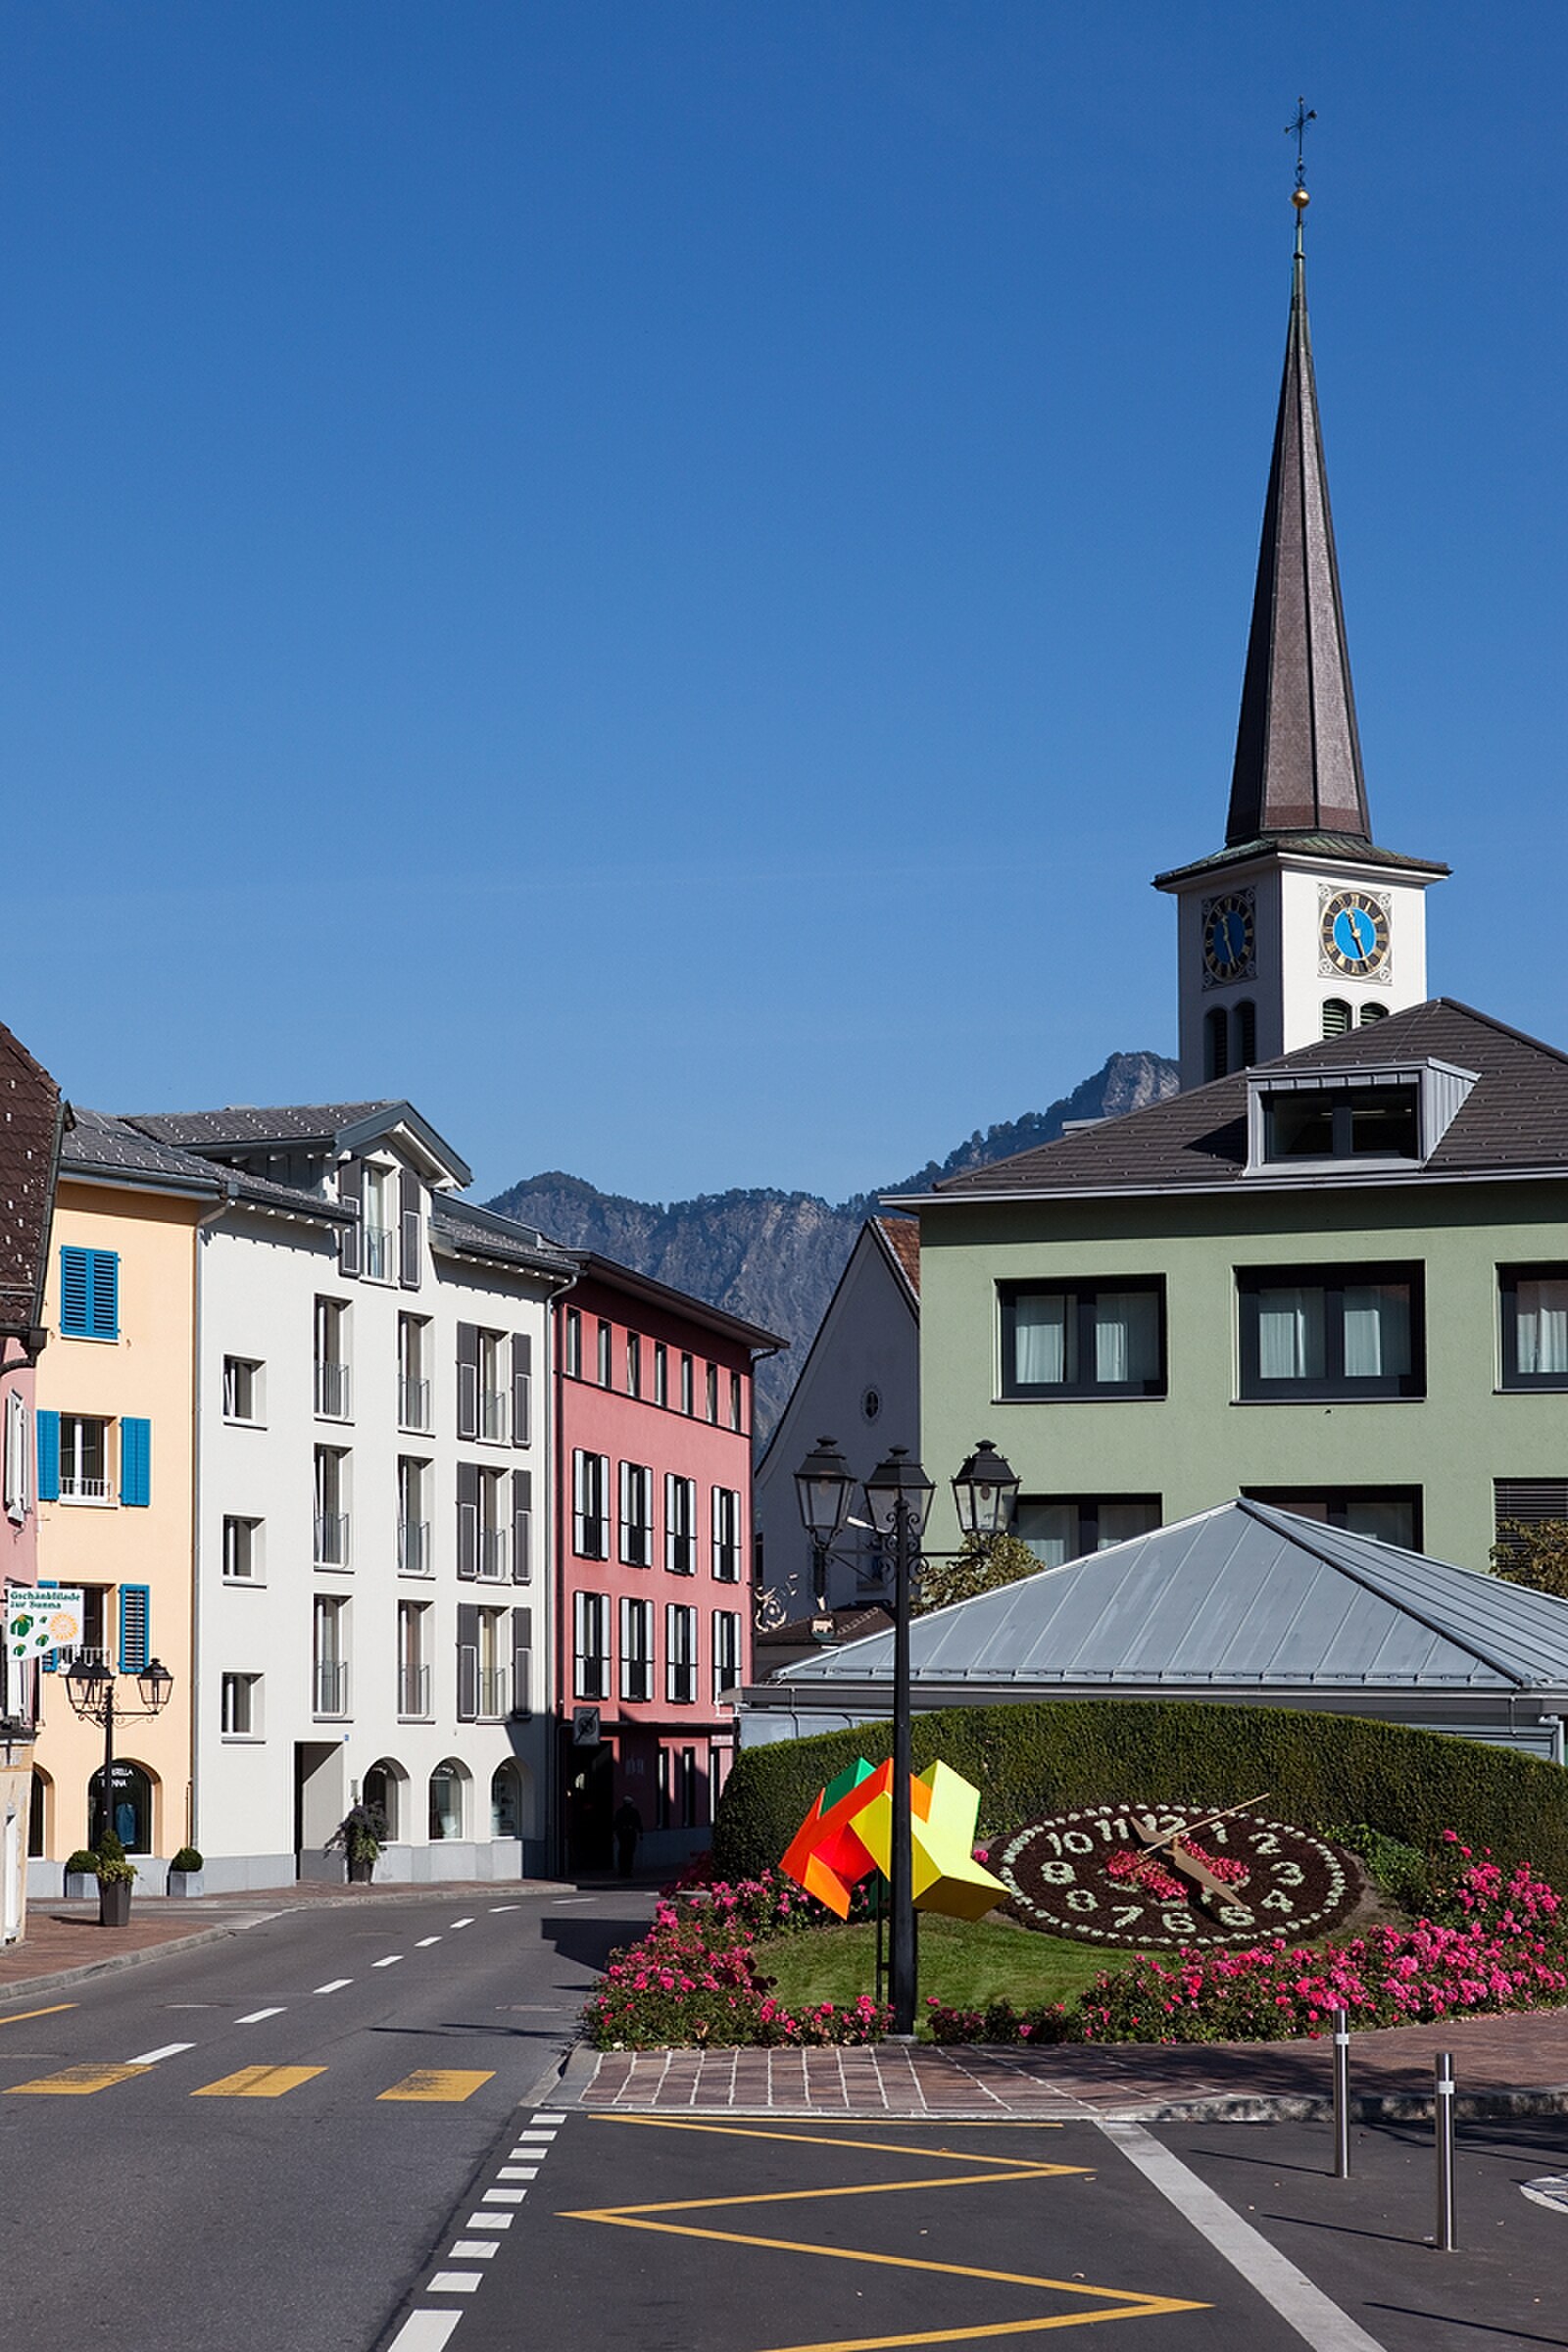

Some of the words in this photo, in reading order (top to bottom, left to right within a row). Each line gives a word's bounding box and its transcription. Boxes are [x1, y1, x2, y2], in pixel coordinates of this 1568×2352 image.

[1094, 1818, 1129, 1841] 11
[1142, 1814, 1187, 1836] 12
[1209, 1821, 1229, 1844] 1
[1046, 1831, 1094, 1856] 10
[1249, 1833, 1282, 1854] 2
[1270, 1862, 1305, 1886] 3
[1065, 1889, 1099, 1912] 8
[1260, 1889, 1294, 1913] 4
[1111, 1905, 1145, 1928] 7
[1162, 1912, 1197, 1933] 6
